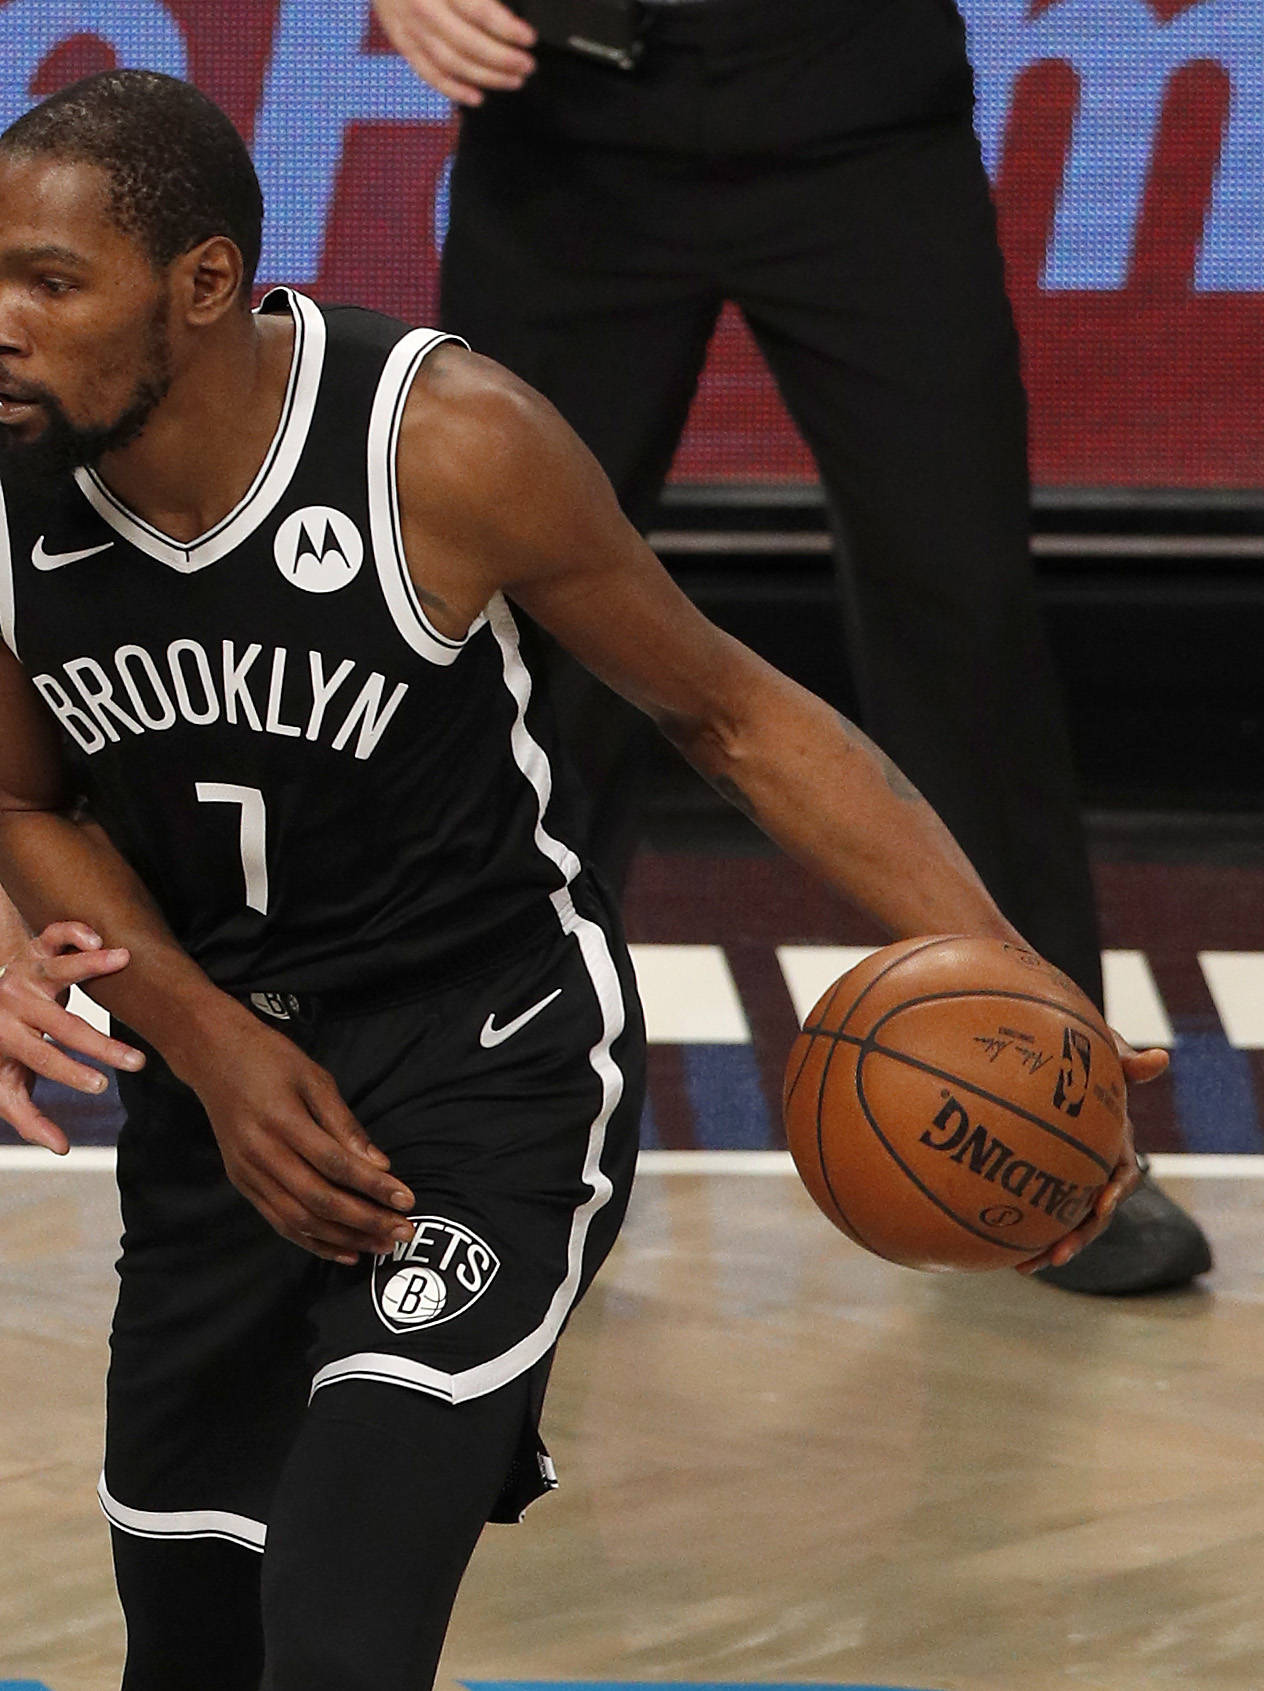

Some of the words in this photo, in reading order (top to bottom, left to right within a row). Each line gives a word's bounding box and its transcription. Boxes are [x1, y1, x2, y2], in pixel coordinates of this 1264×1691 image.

[32, 638, 409, 761] BROOKLYN
[194, 781, 269, 916] 7
[919, 1096, 1104, 1229] PALDING
[397, 1273, 428, 1315] B
